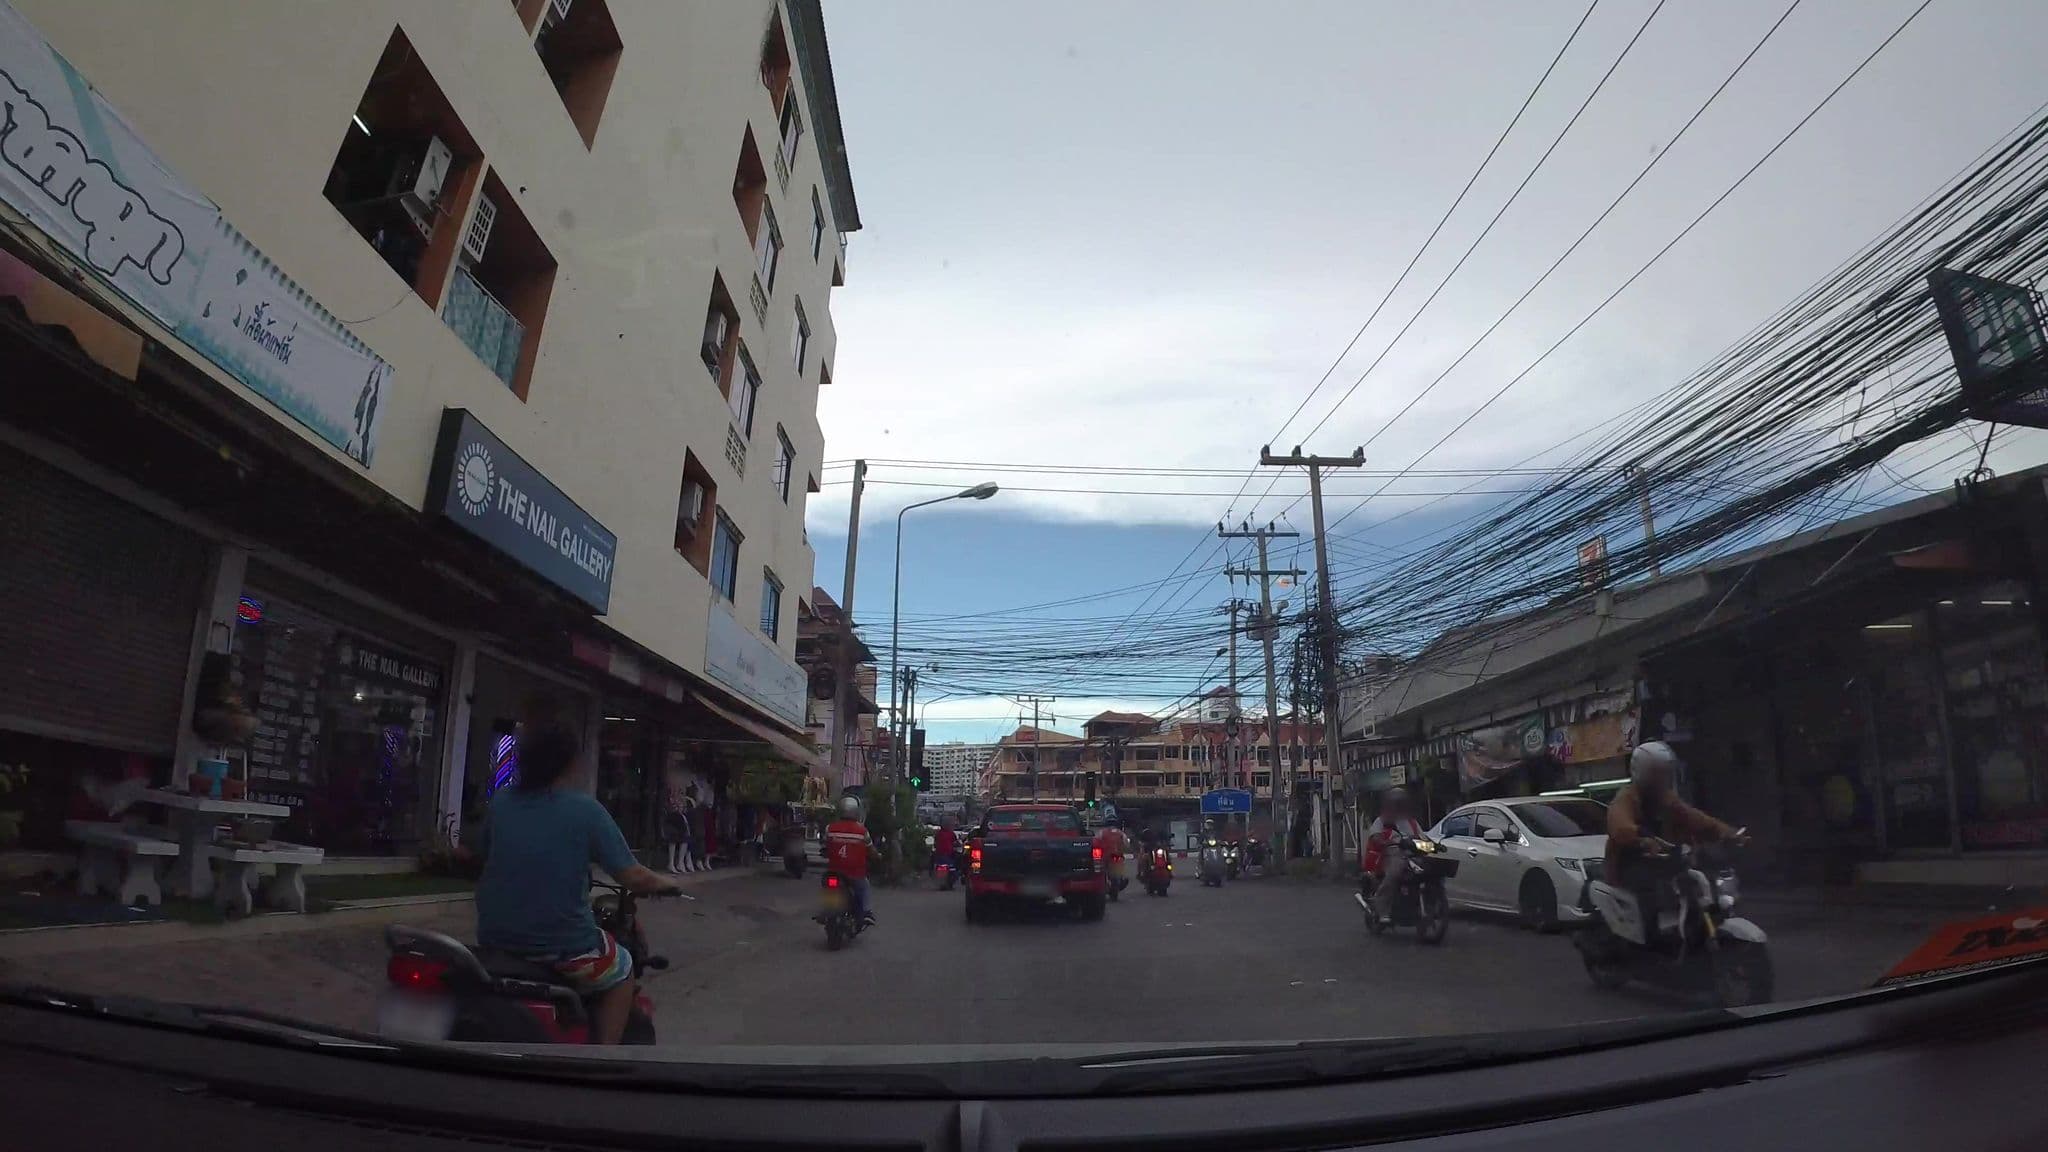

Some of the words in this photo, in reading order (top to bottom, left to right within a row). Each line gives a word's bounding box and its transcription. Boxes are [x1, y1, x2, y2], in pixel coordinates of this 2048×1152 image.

[497, 477, 528, 526] THE
[526, 500, 558, 550] NAIL
[559, 526, 612, 583] GALLERY
[358, 649, 378, 672] THE
[379, 656, 401, 679] NAIL
[402, 663, 440, 689] GALLERY
[838, 843, 848, 859] 4
